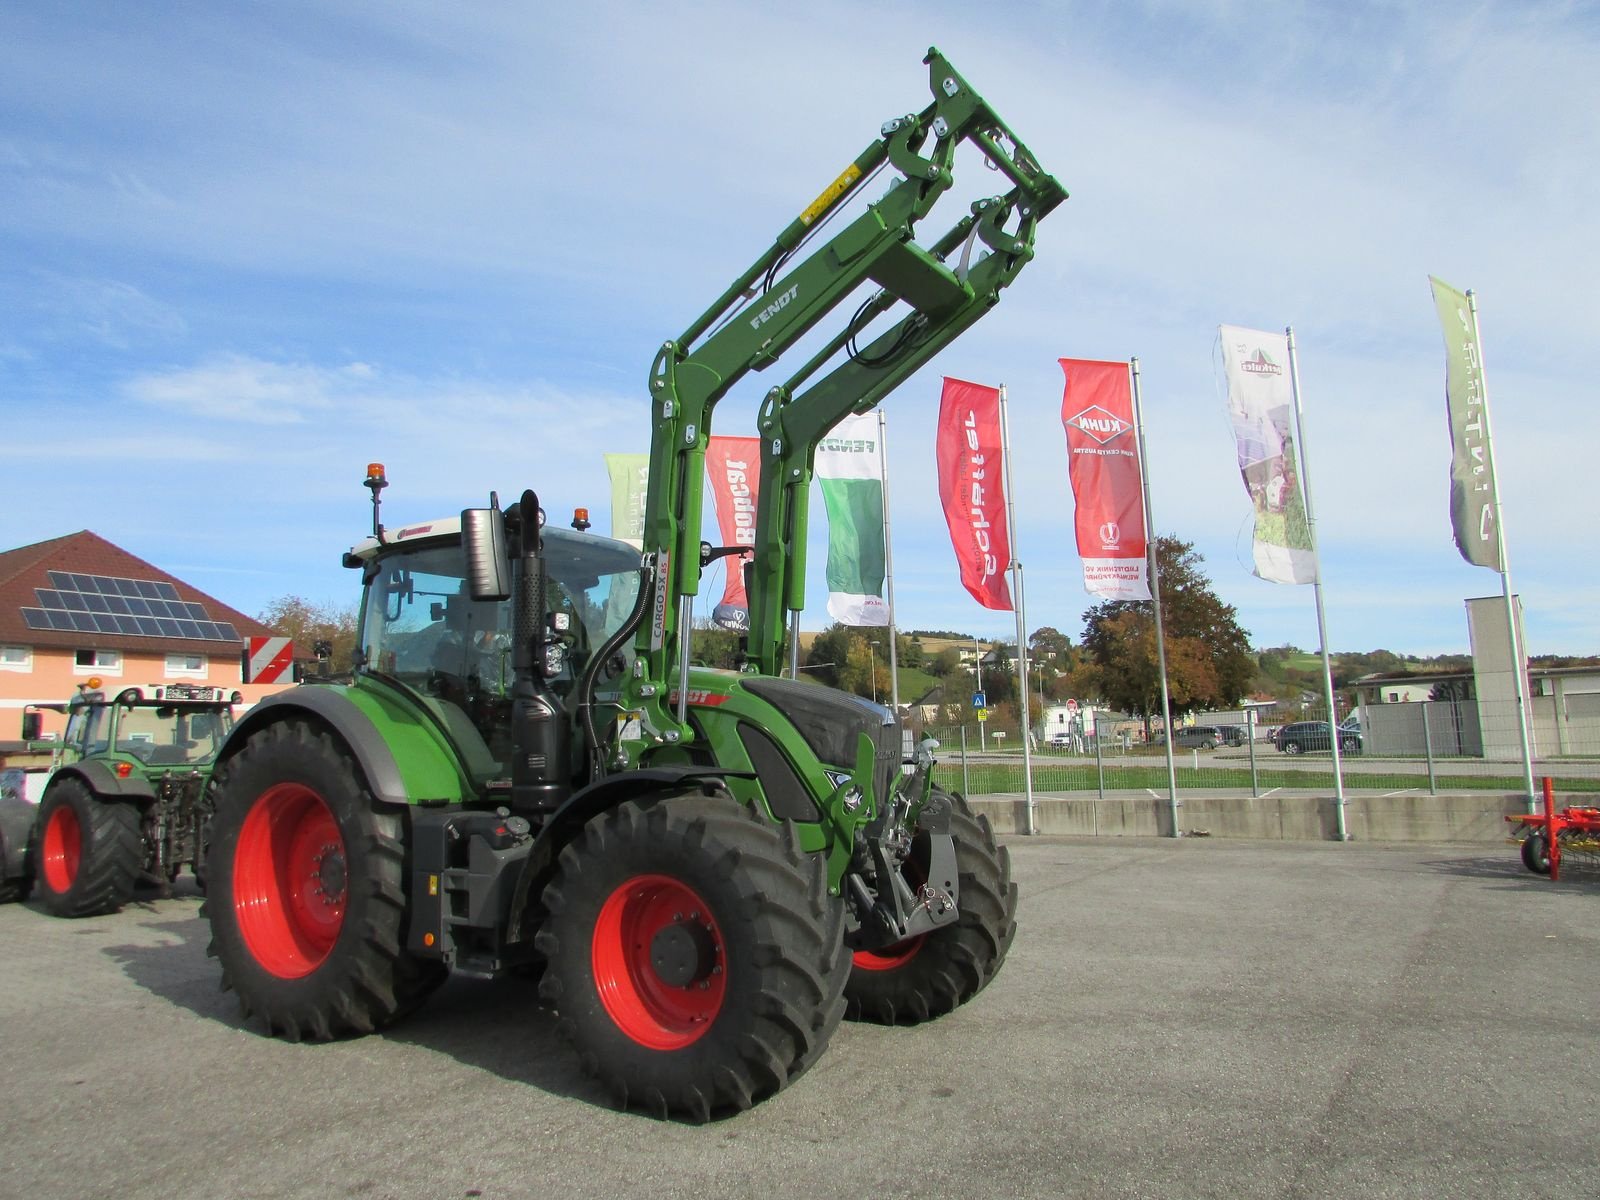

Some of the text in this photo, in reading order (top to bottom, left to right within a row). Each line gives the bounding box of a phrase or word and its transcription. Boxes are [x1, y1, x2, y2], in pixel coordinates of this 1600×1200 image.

[750, 284, 798, 330] FENDT
[654, 562, 668, 638] CARGO SX 85
